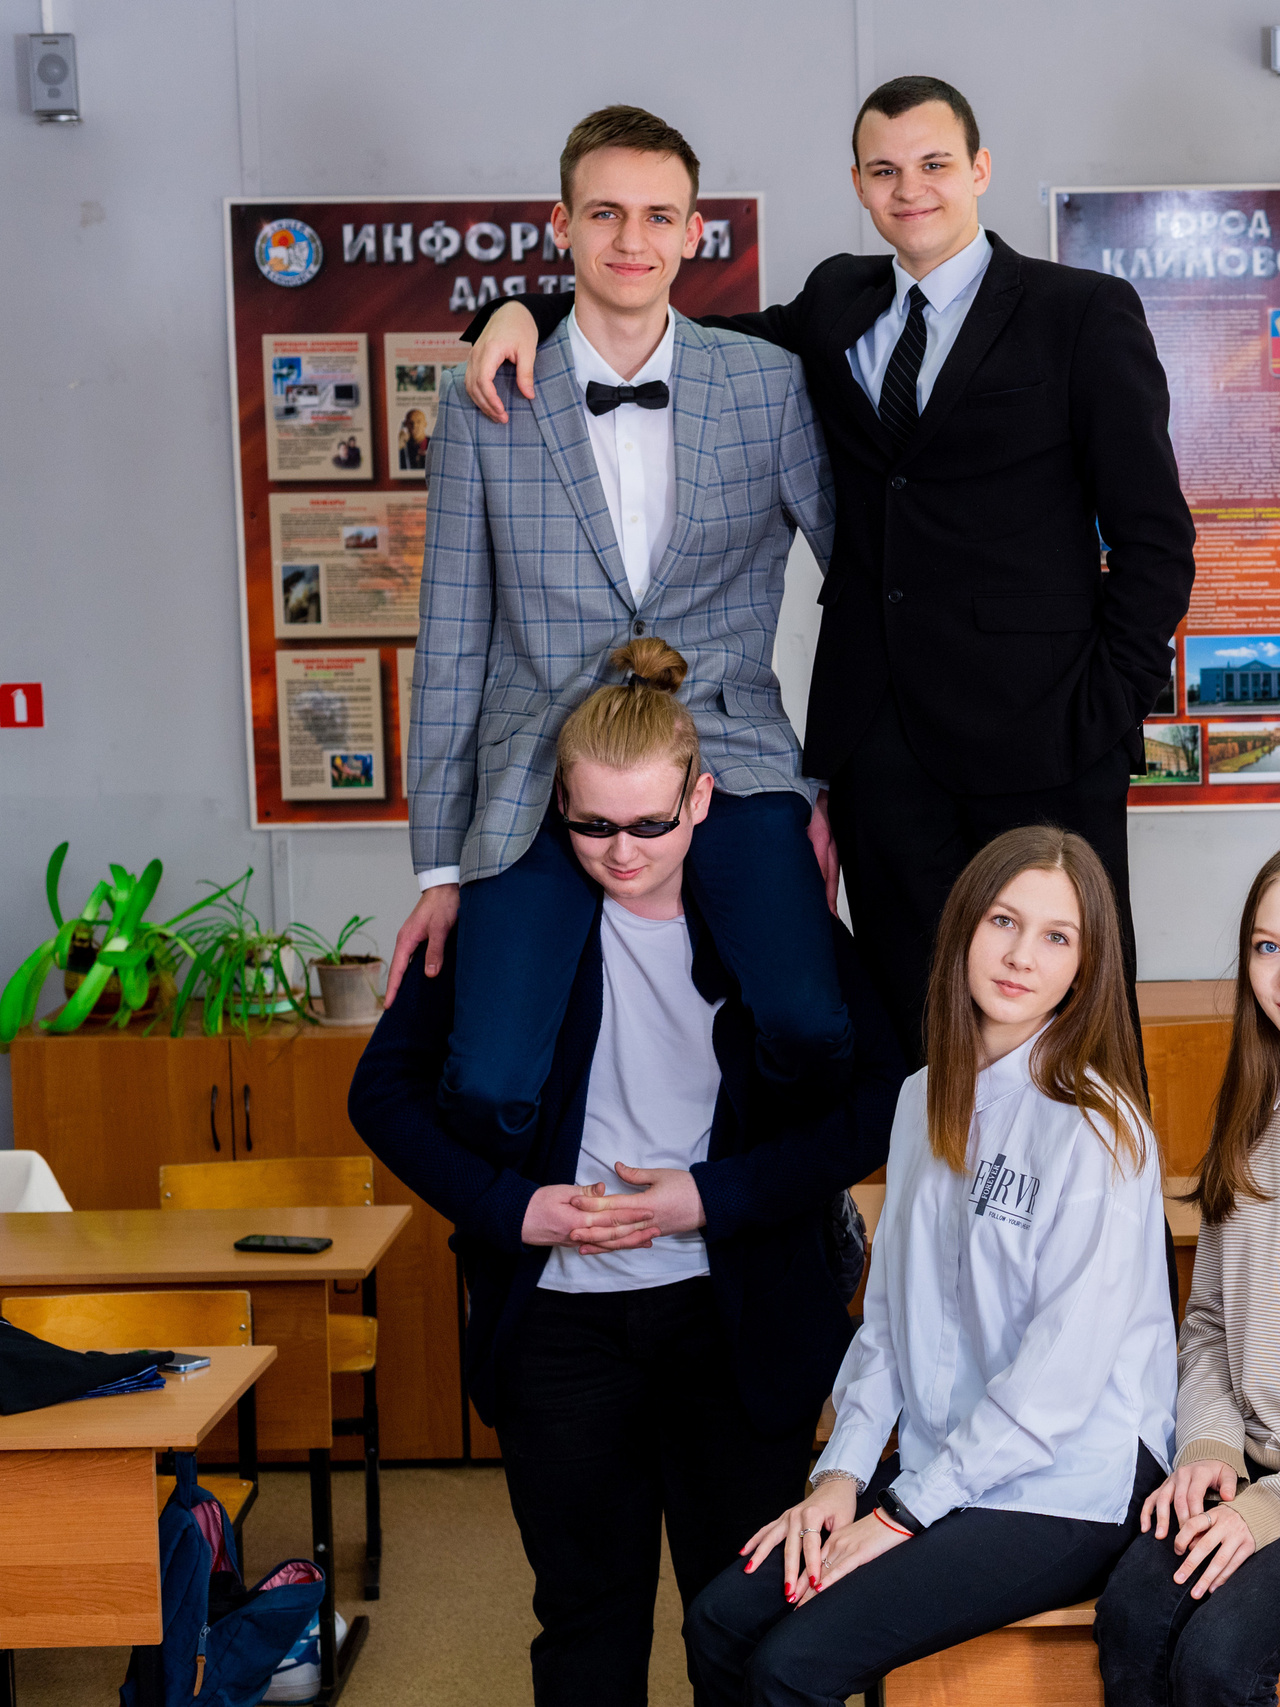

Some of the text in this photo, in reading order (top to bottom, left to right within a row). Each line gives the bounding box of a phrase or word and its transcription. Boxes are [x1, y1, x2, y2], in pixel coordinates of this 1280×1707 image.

[342, 219, 731, 264] ИНФОРЯ
[1154, 208, 1272, 240] ГОРОД
[449, 275, 527, 312] ДЛЯ
